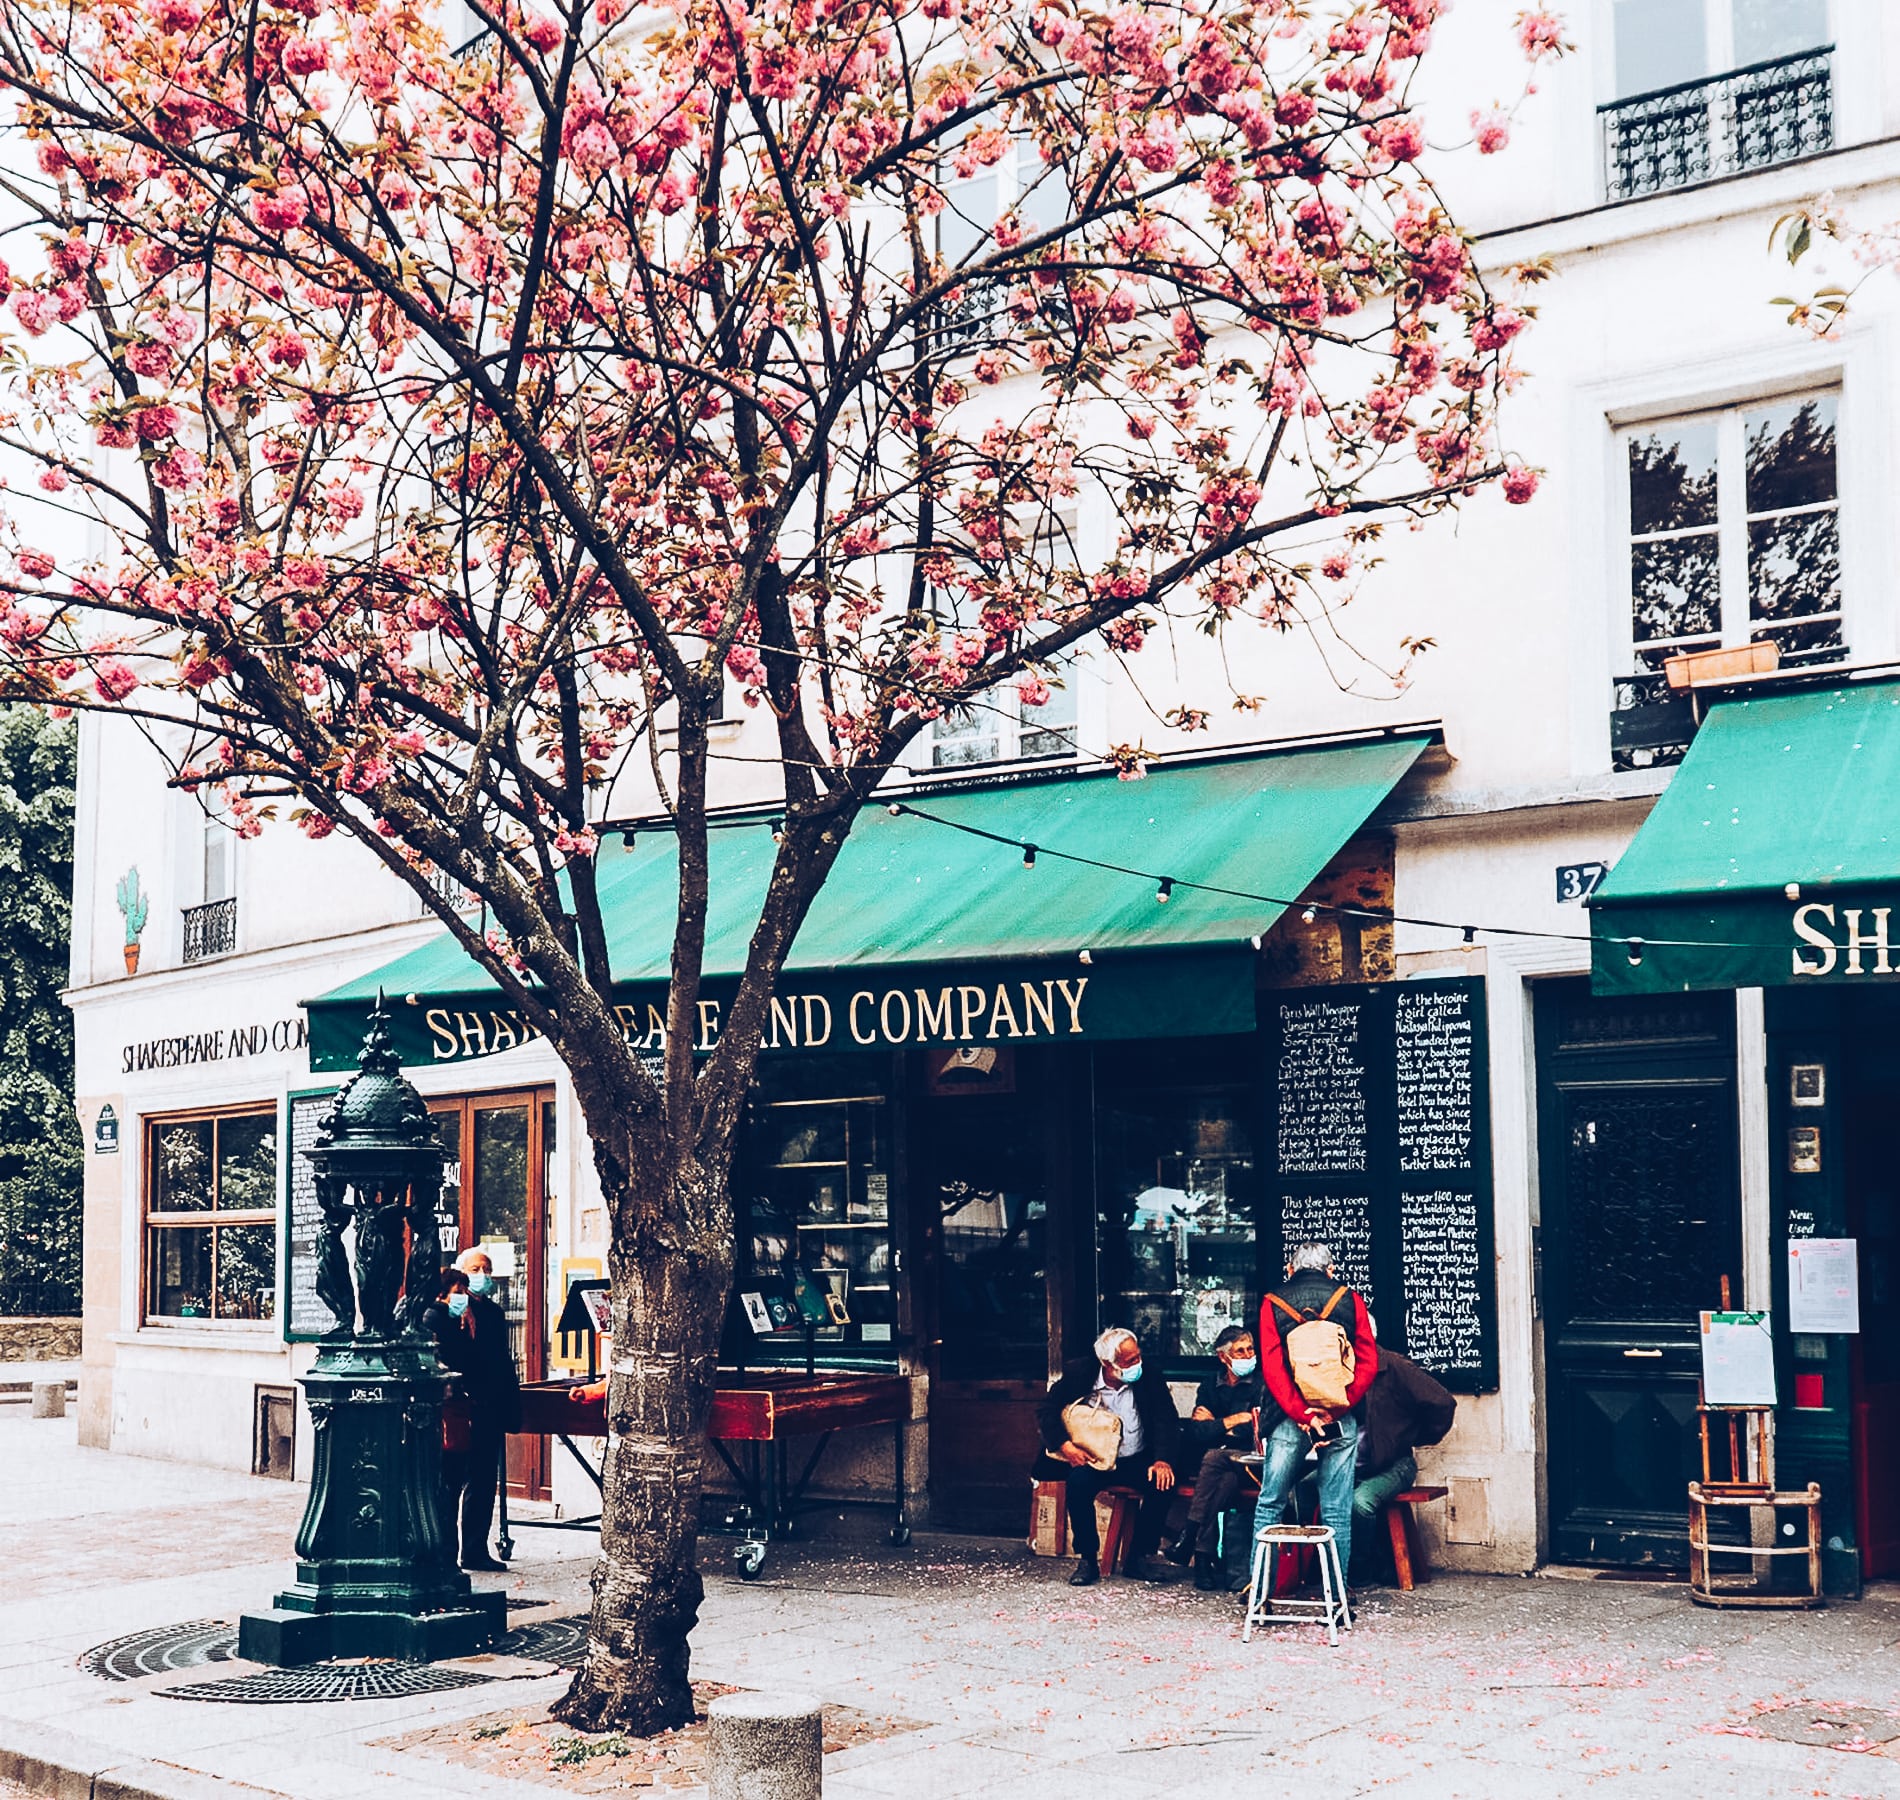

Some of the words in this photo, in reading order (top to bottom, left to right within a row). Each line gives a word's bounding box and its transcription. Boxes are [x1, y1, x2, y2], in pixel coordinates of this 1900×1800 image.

[1563, 866, 1601, 899] 37
[1793, 903, 1900, 977] SH
[1398, 993, 1413, 1008] for
[1415, 993, 1432, 1006] the
[1433, 991, 1468, 1005] heroine
[760, 995, 831, 1048] ND
[850, 977, 1088, 1044] COMPANY
[1395, 1009, 1402, 1019] a
[1404, 1005, 1424, 1022] girl
[1427, 1003, 1462, 1017] called
[1344, 1031, 1358, 1042] call
[1396, 1036, 1413, 1048] One
[1414, 1034, 1449, 1046] hundred
[1449, 1036, 1471, 1049] years
[122, 1030, 223, 1073] SHAKESPEARE
[228, 1025, 267, 1058] AND
[1308, 1046, 1323, 1055] the
[1414, 1050, 1427, 1060] my
[1430, 1046, 1471, 1058] bookstore
[1336, 1054, 1353, 1064] the
[1396, 1061, 1414, 1070] was
[1416, 1060, 1423, 1069] a
[1425, 1058, 1445, 1068] wine
[1447, 1057, 1469, 1071] shop
[1332, 1064, 1364, 1076] because
[1294, 1078, 1316, 1089] head
[1320, 1080, 1328, 1088] is
[1330, 1080, 1341, 1088] so
[1344, 1075, 1359, 1089] far
[1444, 1078, 1456, 1094] of
[1456, 1080, 1471, 1092] the
[1310, 1089, 1324, 1100] the
[1329, 1088, 1362, 1099] clouds
[1436, 1092, 1471, 1109] hospital
[1353, 1099, 1365, 1111] all
[1302, 1116, 1316, 1124] are
[1319, 1112, 1350, 1125] angels
[1354, 1112, 1364, 1121] in
[1399, 1108, 1426, 1121] which
[1428, 1106, 1444, 1119] has
[1445, 1108, 1471, 1119] since
[1399, 1122, 1418, 1134] been
[1420, 1118, 1471, 1132] demolished
[1399, 1134, 1414, 1147] and
[1415, 1133, 1456, 1150] replaced
[1458, 1133, 1471, 1149] by
[1349, 1147, 1367, 1157] like
[1412, 1147, 1420, 1157] a
[1400, 1156, 1432, 1171] Further
[1433, 1156, 1457, 1169] back
[1459, 1156, 1471, 1169] in
[1281, 1195, 1302, 1209] This
[1324, 1195, 1341, 1207] has
[1342, 1197, 1369, 1206] rooms
[1402, 1192, 1415, 1203] the
[1416, 1194, 1434, 1206] year
[1434, 1190, 1452, 1203] 1600
[1455, 1193, 1473, 1203] our
[1303, 1207, 1343, 1220] chapters
[1345, 1206, 1354, 1216] in
[1357, 1207, 1364, 1216] a
[1402, 1203, 1423, 1215] whole
[1424, 1203, 1457, 1219] building
[1458, 1205, 1477, 1215] was
[1282, 1219, 1305, 1230] novel
[1307, 1219, 1323, 1229] and
[1325, 1218, 1340, 1229] the
[1340, 1217, 1357, 1232] fact
[1361, 1217, 1370, 1228] is
[1402, 1217, 1408, 1226] a
[1408, 1214, 1449, 1230] monastery
[1450, 1214, 1477, 1226] called
[1788, 1223, 1815, 1234] Used
[1313, 1227, 1328, 1239] and
[1403, 1241, 1412, 1252] In
[1450, 1239, 1477, 1252] times
[1344, 1251, 1369, 1261] door
[1402, 1252, 1421, 1263] each
[1421, 1252, 1462, 1268] monastery
[1462, 1252, 1479, 1265] had
[1348, 1264, 1370, 1272] even
[1403, 1265, 1409, 1275] a
[1342, 1271, 1351, 1281] is
[1353, 1271, 1370, 1282] the
[1404, 1275, 1427, 1287] whose
[1430, 1275, 1455, 1292] duty
[1457, 1279, 1476, 1289] was
[1405, 1287, 1414, 1300] to
[1415, 1287, 1437, 1305] light
[1439, 1287, 1454, 1300] the
[1455, 1287, 1481, 1306] lamps
[1411, 1301, 1422, 1313] at
[1405, 1308, 1410, 1327] I
[1411, 1312, 1432, 1326] have
[1432, 1312, 1452, 1325] been
[1453, 1313, 1481, 1330] doing
[1406, 1326, 1424, 1337] this
[1425, 1324, 1437, 1340] for
[1437, 1324, 1457, 1341] fifty
[1407, 1336, 1428, 1349] Now
[1430, 1334, 1439, 1347] it
[1441, 1336, 1451, 1346] is
[1455, 1338, 1473, 1352] my
